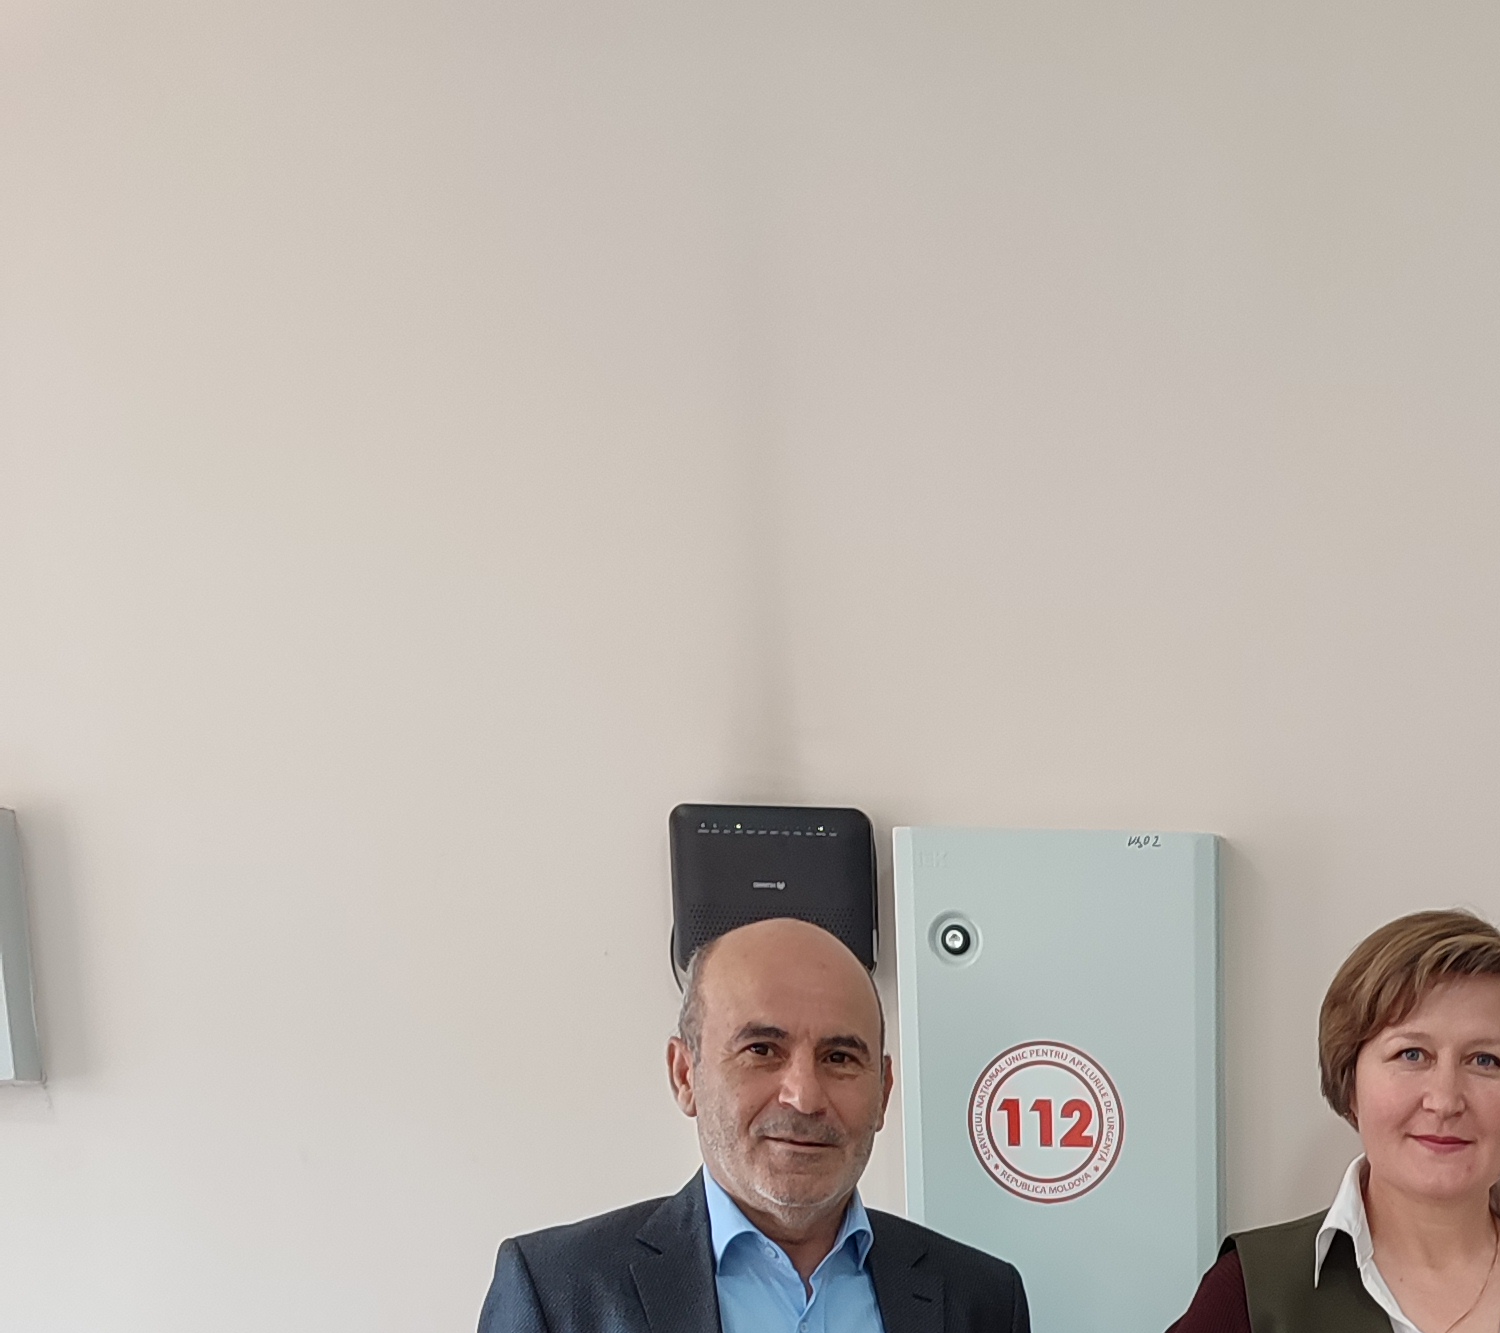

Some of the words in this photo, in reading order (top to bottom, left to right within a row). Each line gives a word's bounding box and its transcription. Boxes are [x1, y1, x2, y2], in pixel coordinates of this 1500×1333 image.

[975, 1110, 993, 1161] SERVICIUL
[1005, 1049, 1029, 1067] UNIC
[1029, 1048, 1069, 1061] PENTRU
[1069, 1056, 1109, 1098] APELURILE
[1103, 1100, 1114, 1114] DE
[997, 1098, 1094, 1148] 112
[1000, 1168, 1047, 1194] REPUBLICA
[1048, 1171, 1092, 1195] MOLDOVA
